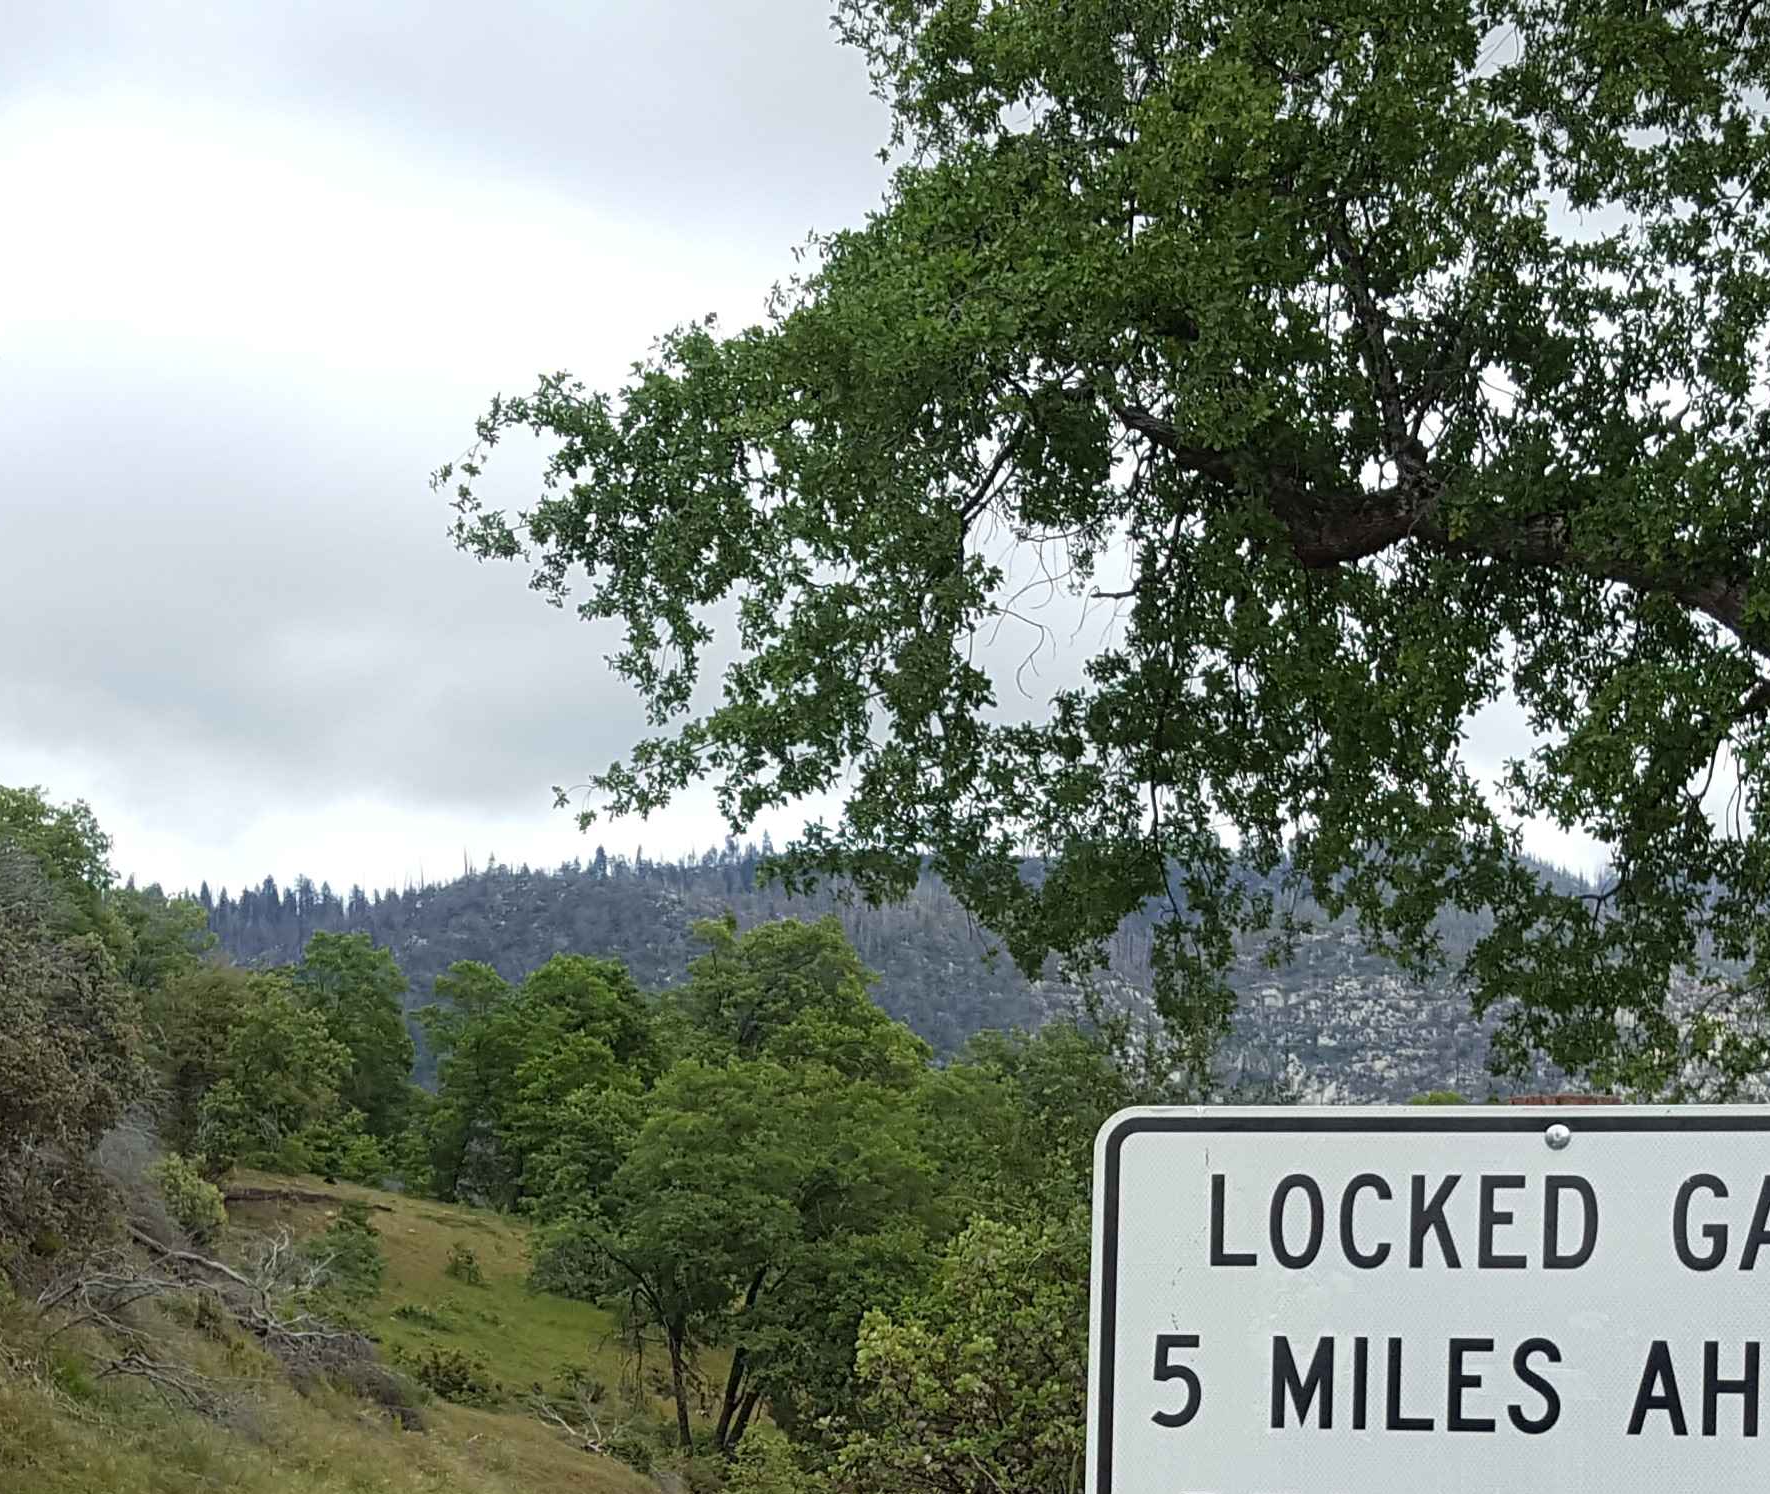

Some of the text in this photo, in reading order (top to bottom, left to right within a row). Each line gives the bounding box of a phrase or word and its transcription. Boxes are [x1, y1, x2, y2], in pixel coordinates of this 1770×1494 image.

[1210, 1173, 1599, 1270] LOCKED
[1151, 1334, 1203, 1428] 5
[1271, 1335, 1563, 1435] MILES
